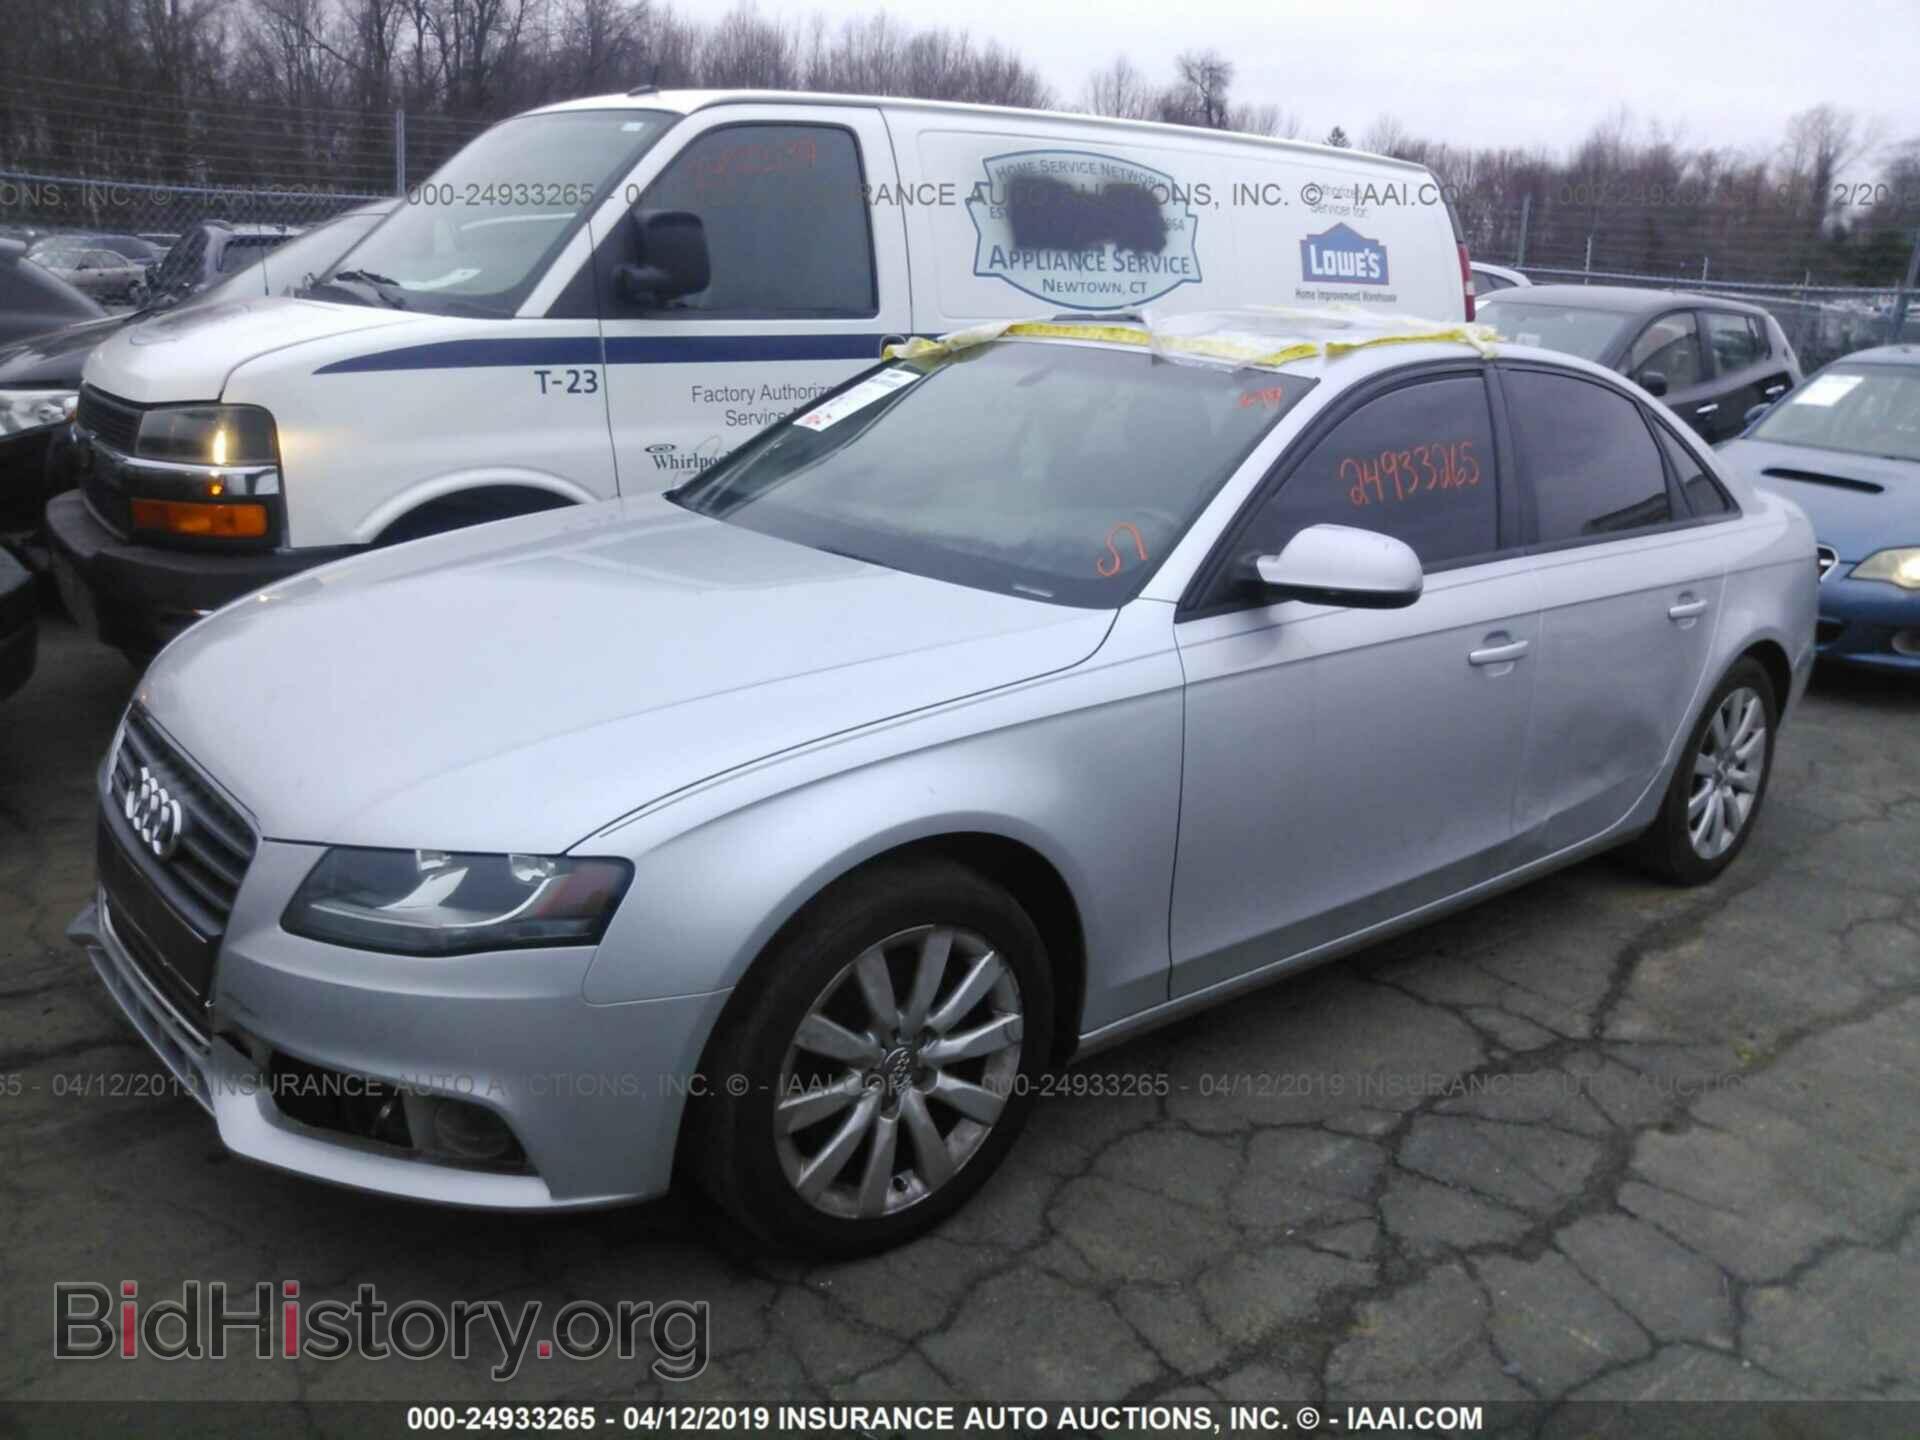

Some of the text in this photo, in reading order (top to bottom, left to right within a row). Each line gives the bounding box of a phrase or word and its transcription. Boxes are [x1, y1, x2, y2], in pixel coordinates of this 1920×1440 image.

[1040, 159, 1096, 176] SERVICE
[1101, 162, 1164, 188] NETWOR
[989, 245, 1190, 274] APPLIANCE SERVICE
[1042, 278, 1148, 295] NEWTOWN, CT
[534, 369, 599, 394] T-23
[691, 384, 756, 406] Factory
[1339, 441, 1480, 506] 24933265
